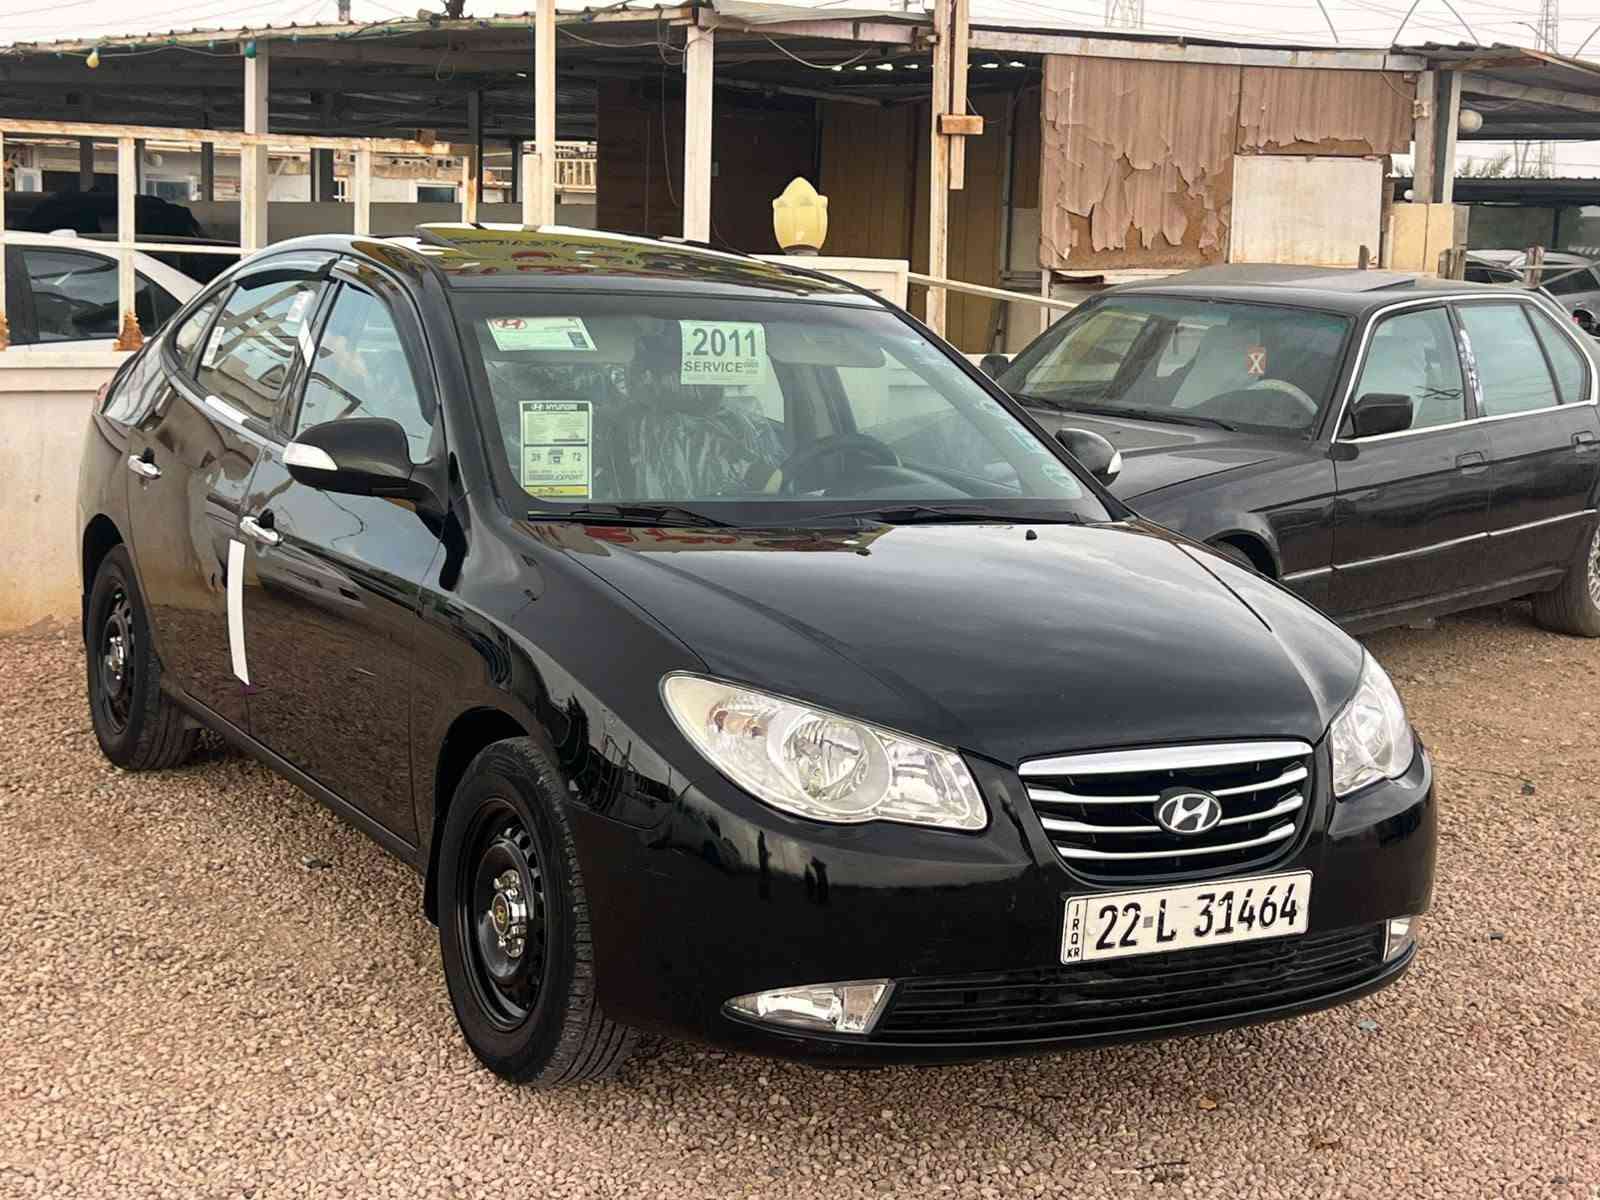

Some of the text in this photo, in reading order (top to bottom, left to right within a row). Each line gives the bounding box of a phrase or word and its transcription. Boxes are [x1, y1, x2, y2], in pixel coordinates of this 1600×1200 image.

[683, 360, 744, 373] SERVICE
[1096, 902, 1142, 950] 22
[1193, 883, 1298, 937] 31464
